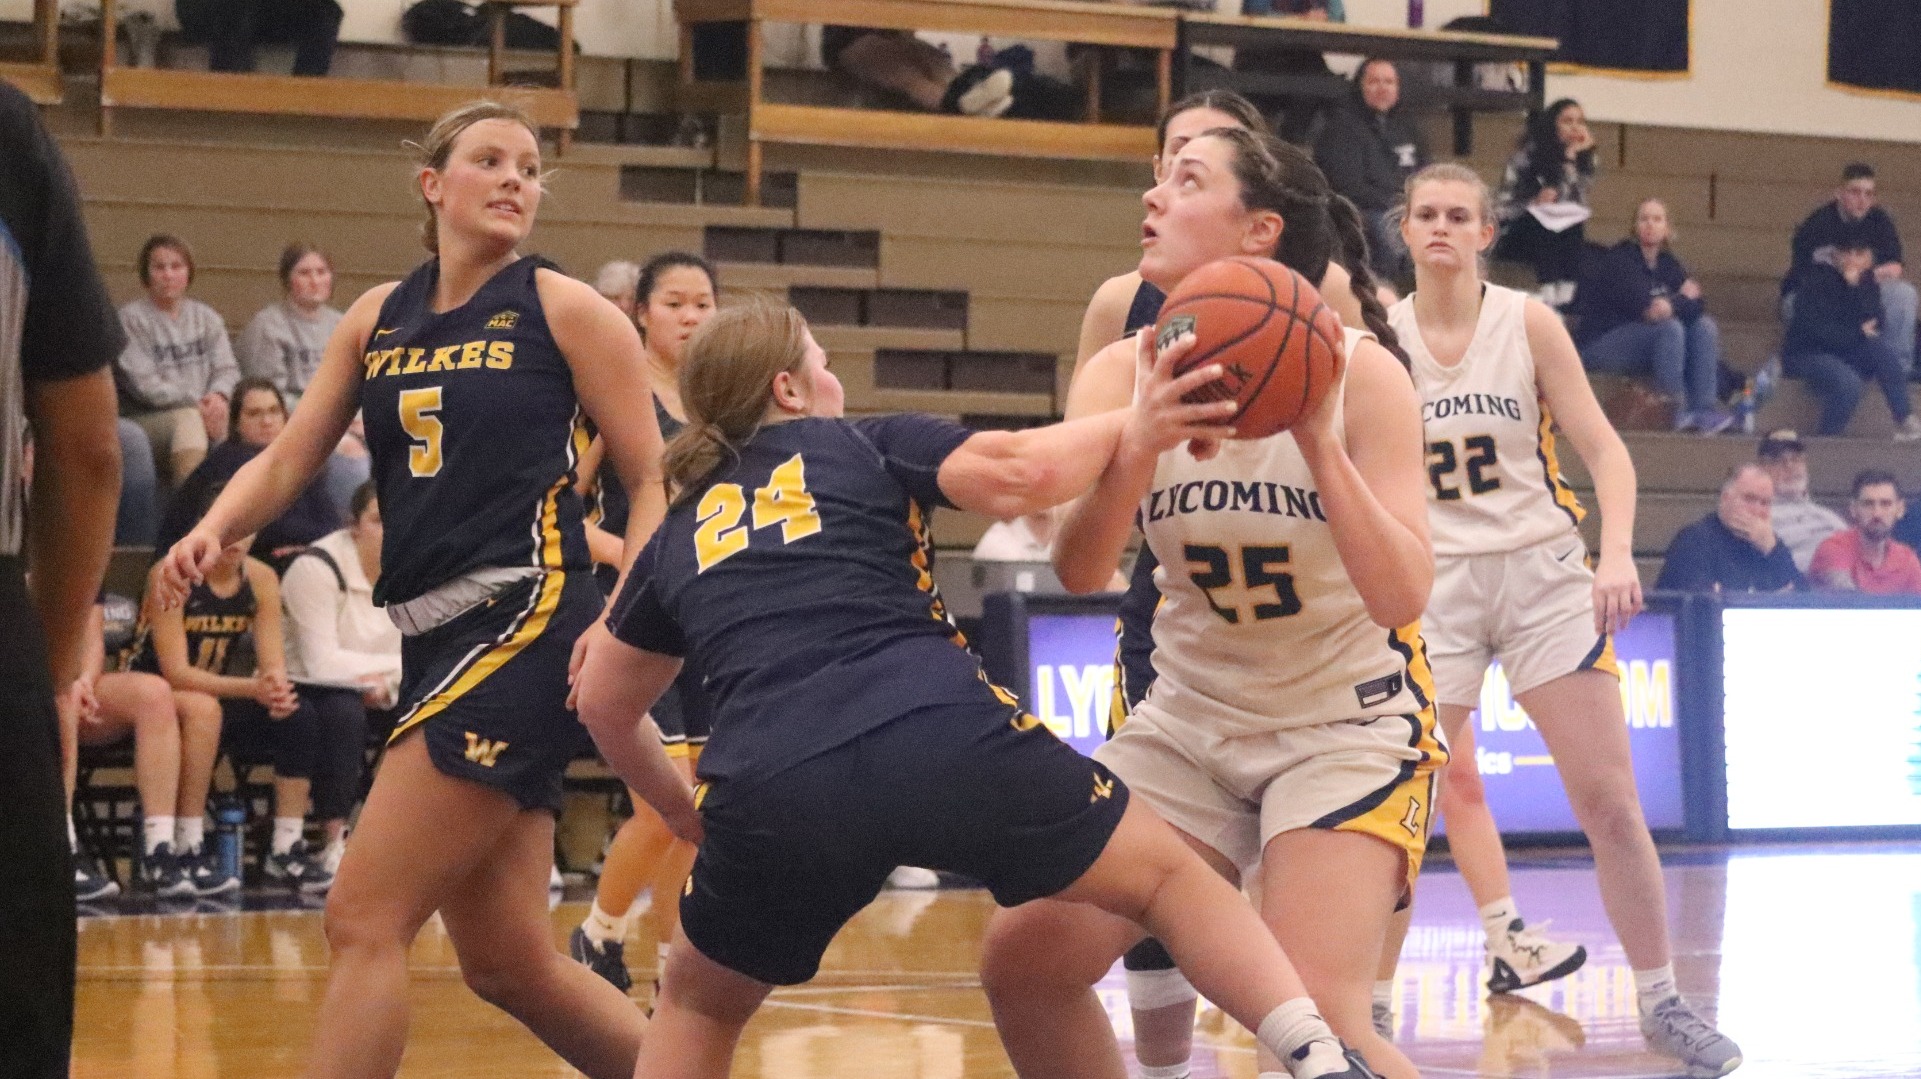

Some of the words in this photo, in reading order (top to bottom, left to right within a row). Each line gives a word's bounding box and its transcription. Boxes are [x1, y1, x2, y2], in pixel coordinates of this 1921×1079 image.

[363, 341, 515, 381] WILKES
[398, 386, 443, 478] 5
[1425, 434, 1502, 501] 22
[693, 452, 822, 575] 24
[1182, 543, 1303, 624] 25
[464, 730, 511, 768] W
[1400, 795, 1420, 839] L
